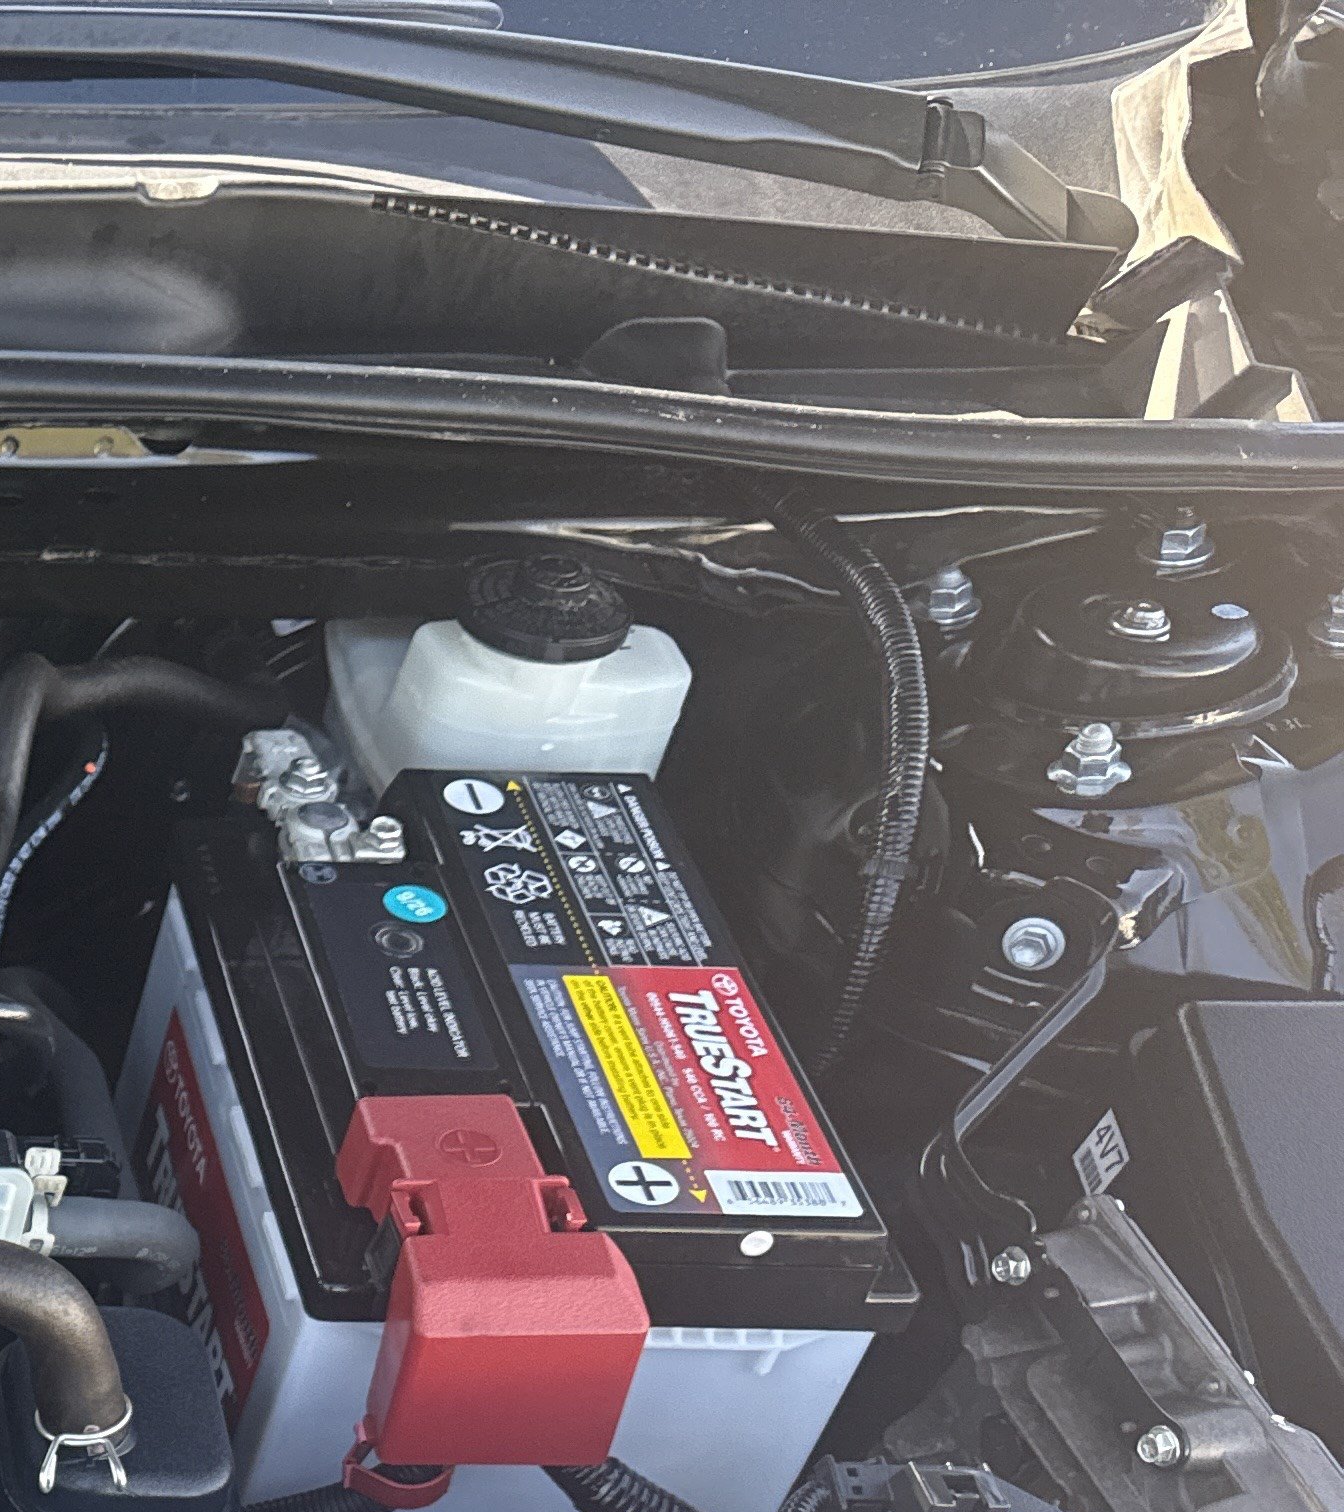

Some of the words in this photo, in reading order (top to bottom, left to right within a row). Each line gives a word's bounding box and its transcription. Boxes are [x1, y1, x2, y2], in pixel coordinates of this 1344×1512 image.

[724, 997, 769, 1057] TOYOTA
[668, 988, 780, 1149] TRUESTART
[688, 1084, 709, 1103] CCA
[174, 1077, 207, 1185] TOYOTA
[1095, 1123, 1125, 1173] 4V7
